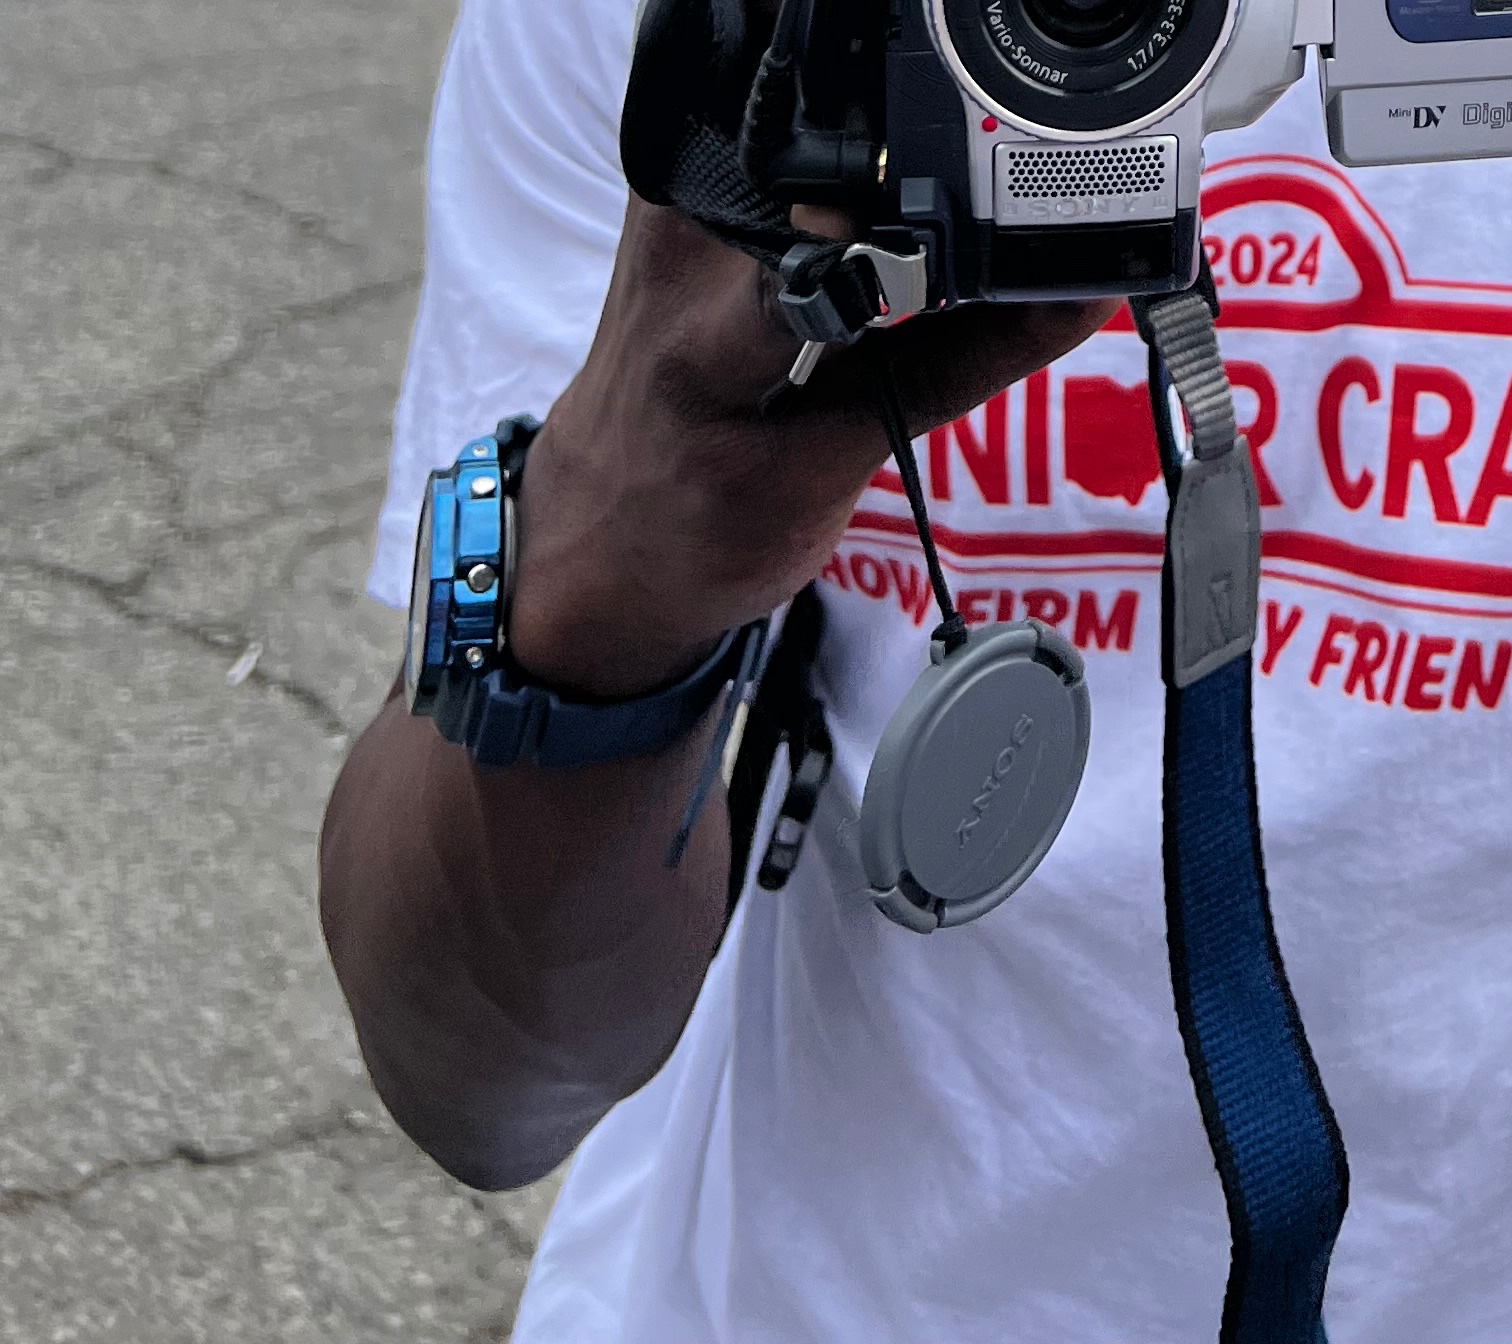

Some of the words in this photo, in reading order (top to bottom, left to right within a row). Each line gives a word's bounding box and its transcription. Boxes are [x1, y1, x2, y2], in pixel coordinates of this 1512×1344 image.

[987, 0, 1068, 85] Vario-Sonnar
[1388, 108, 1412, 118] Mini
[1413, 105, 1447, 128] DV
[1027, 193, 1143, 217] SONY
[1201, 232, 1321, 287] 2024
[953, 588, 1140, 652] FIRM
